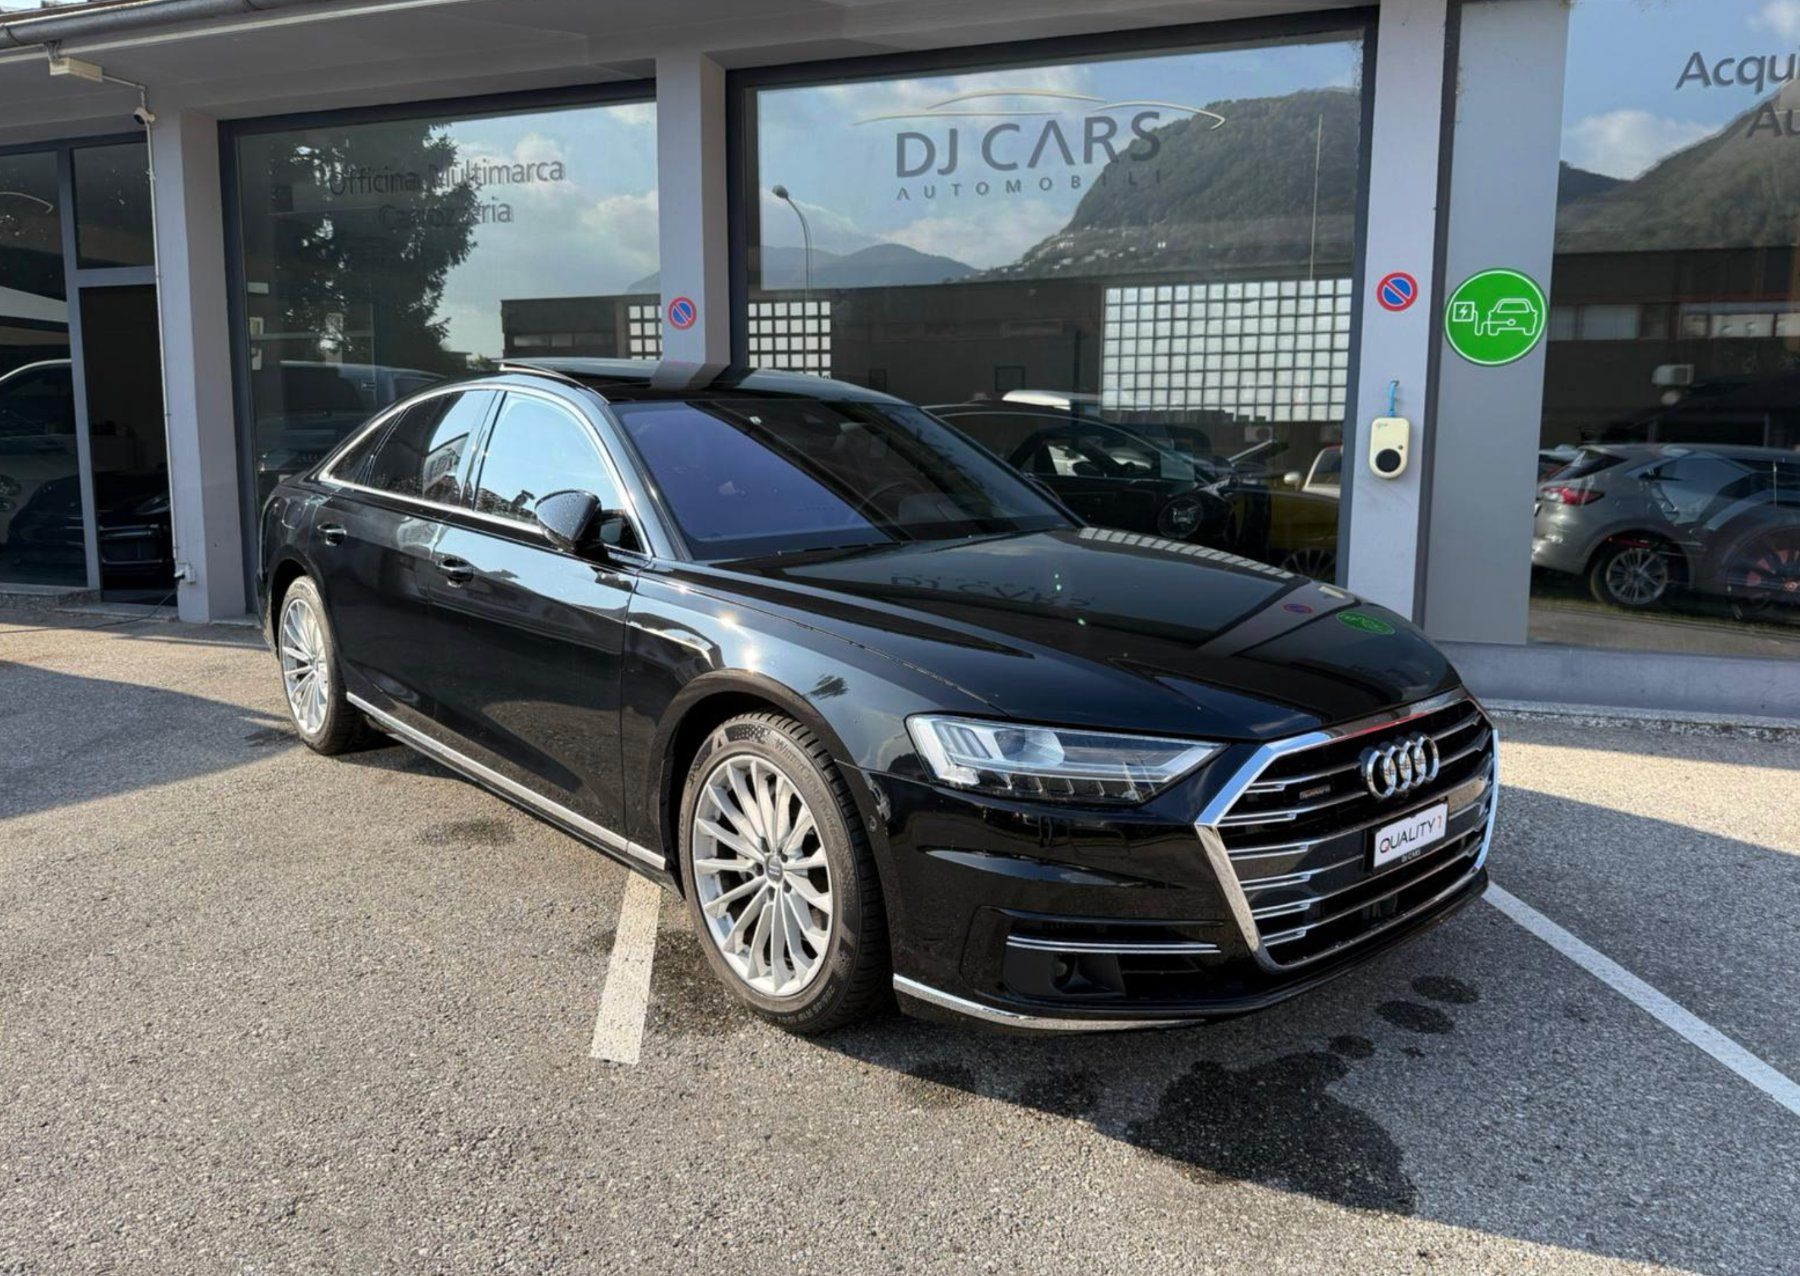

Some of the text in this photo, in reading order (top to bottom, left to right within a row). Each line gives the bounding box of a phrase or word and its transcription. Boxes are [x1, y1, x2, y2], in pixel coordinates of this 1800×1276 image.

[1675, 46, 1800, 95] Acqu
[896, 111, 1161, 178] DJ CARS
[330, 158, 564, 196] Officina Multimarca
[897, 168, 1161, 201] AUTOMOBILI
